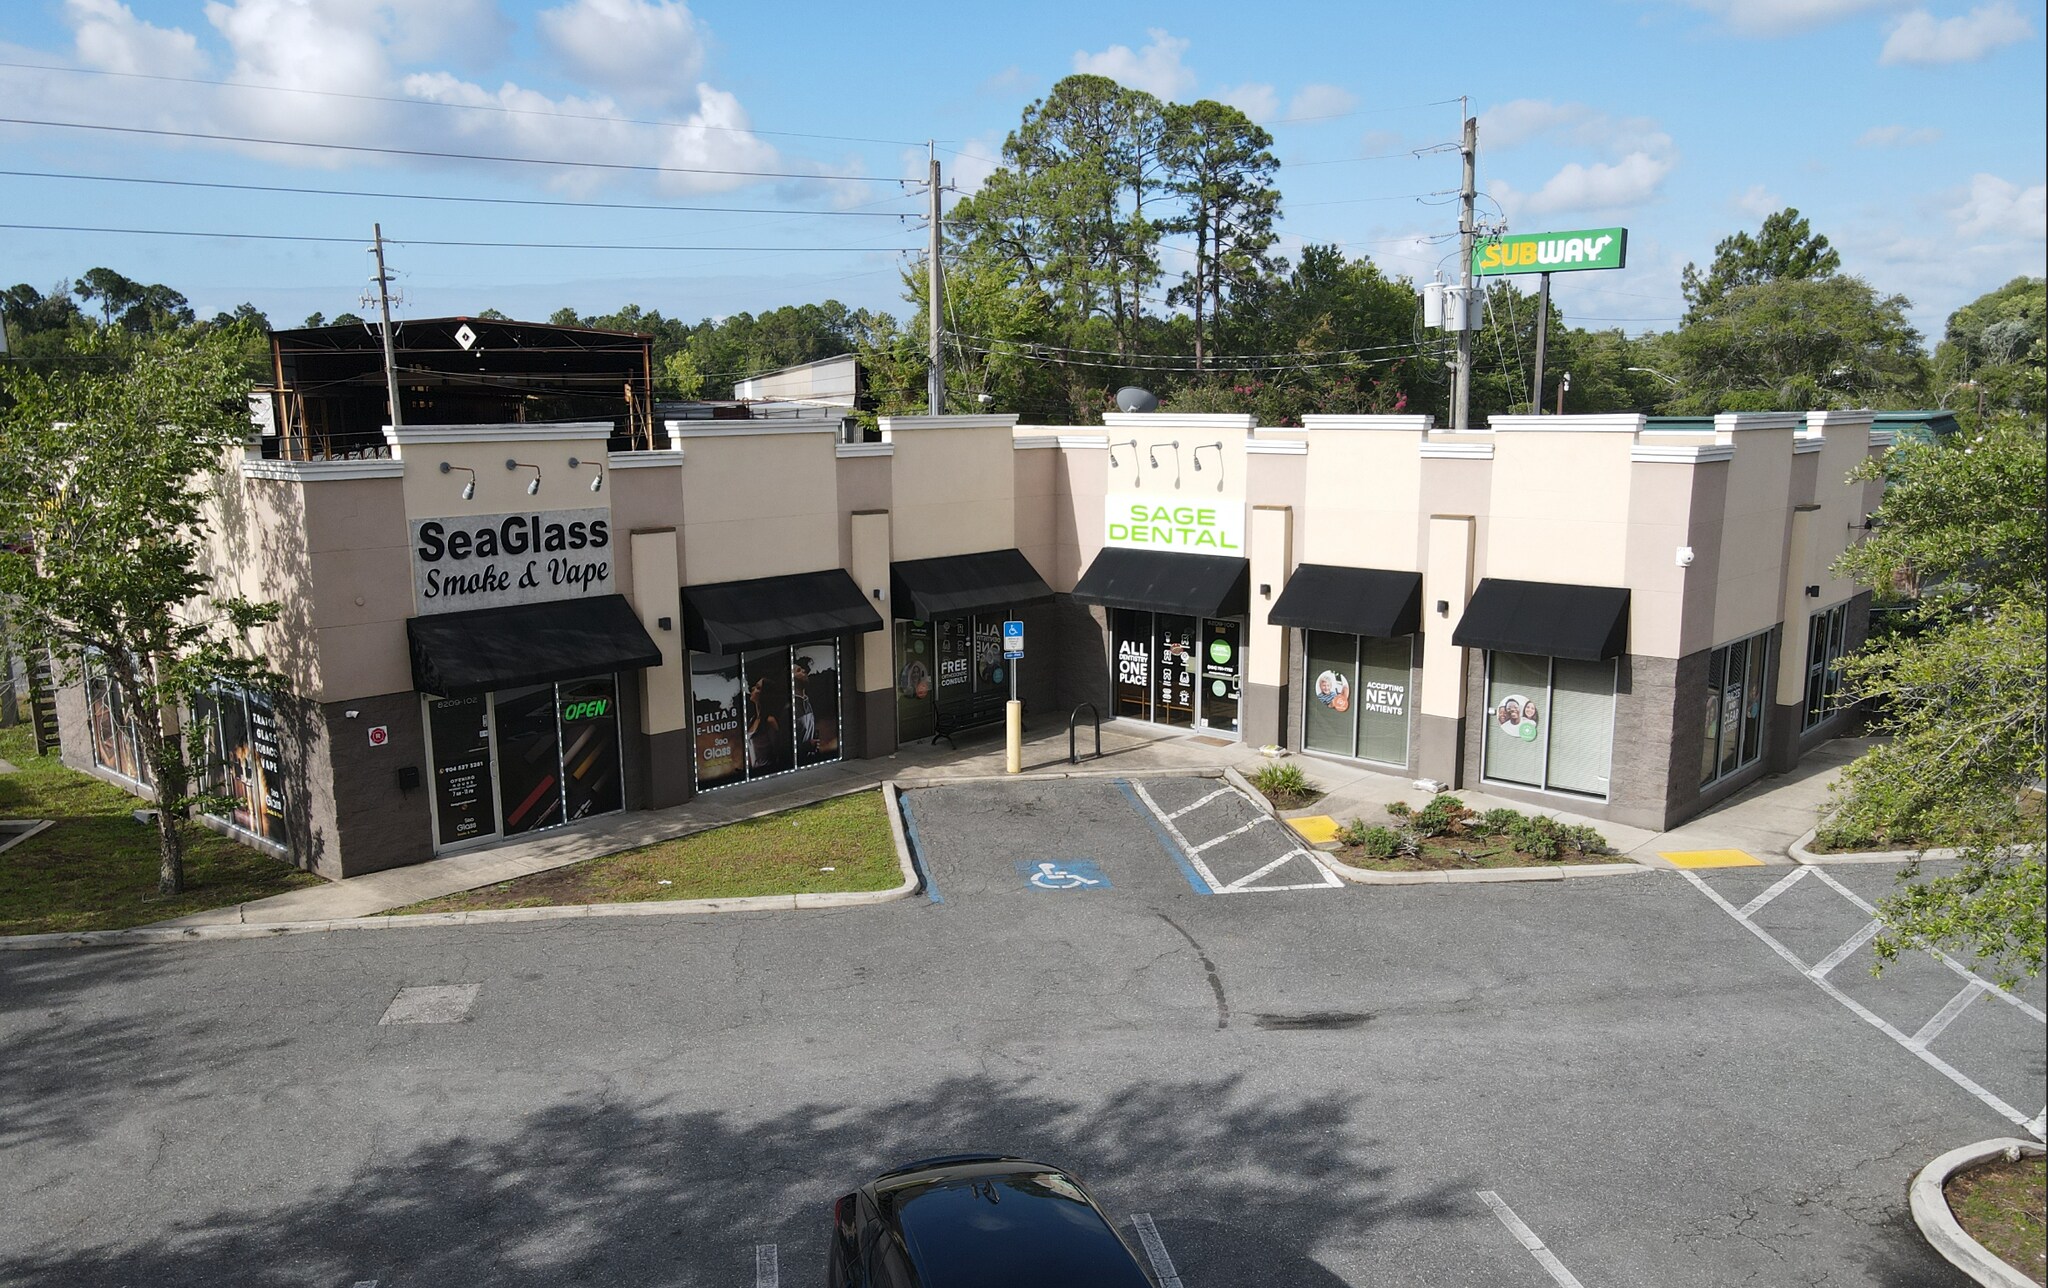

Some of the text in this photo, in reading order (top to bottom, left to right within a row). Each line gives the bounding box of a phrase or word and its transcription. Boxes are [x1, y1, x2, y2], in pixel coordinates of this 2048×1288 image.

[1481, 235, 1612, 269] SUBWAY
[1130, 504, 1216, 526] SAGE
[418, 516, 609, 562] SeaGlass
[1109, 523, 1238, 549] DENTAL
[424, 558, 609, 598] Smoke & Vape
[1119, 640, 1148, 657] ALL
[941, 658, 967, 674] FREE
[1119, 653, 1148, 664] DENTISTRY
[1119, 660, 1148, 676] ONE
[941, 675, 967, 687] CONSULT
[1119, 672, 1148, 687] PLACE
[1366, 681, 1404, 693] ACCEPTING
[437, 697, 478, 709] 8209-102
[1366, 689, 1404, 707] NEW
[565, 699, 607, 721] OPEN
[696, 708, 737, 724] DELTA 8
[1366, 703, 1403, 716] PATIENTS
[256, 728, 277, 744] GLASS
[696, 720, 738, 736] E-LIQUED
[260, 757, 278, 773] VAPE
[450, 775, 475, 784] OPENING
